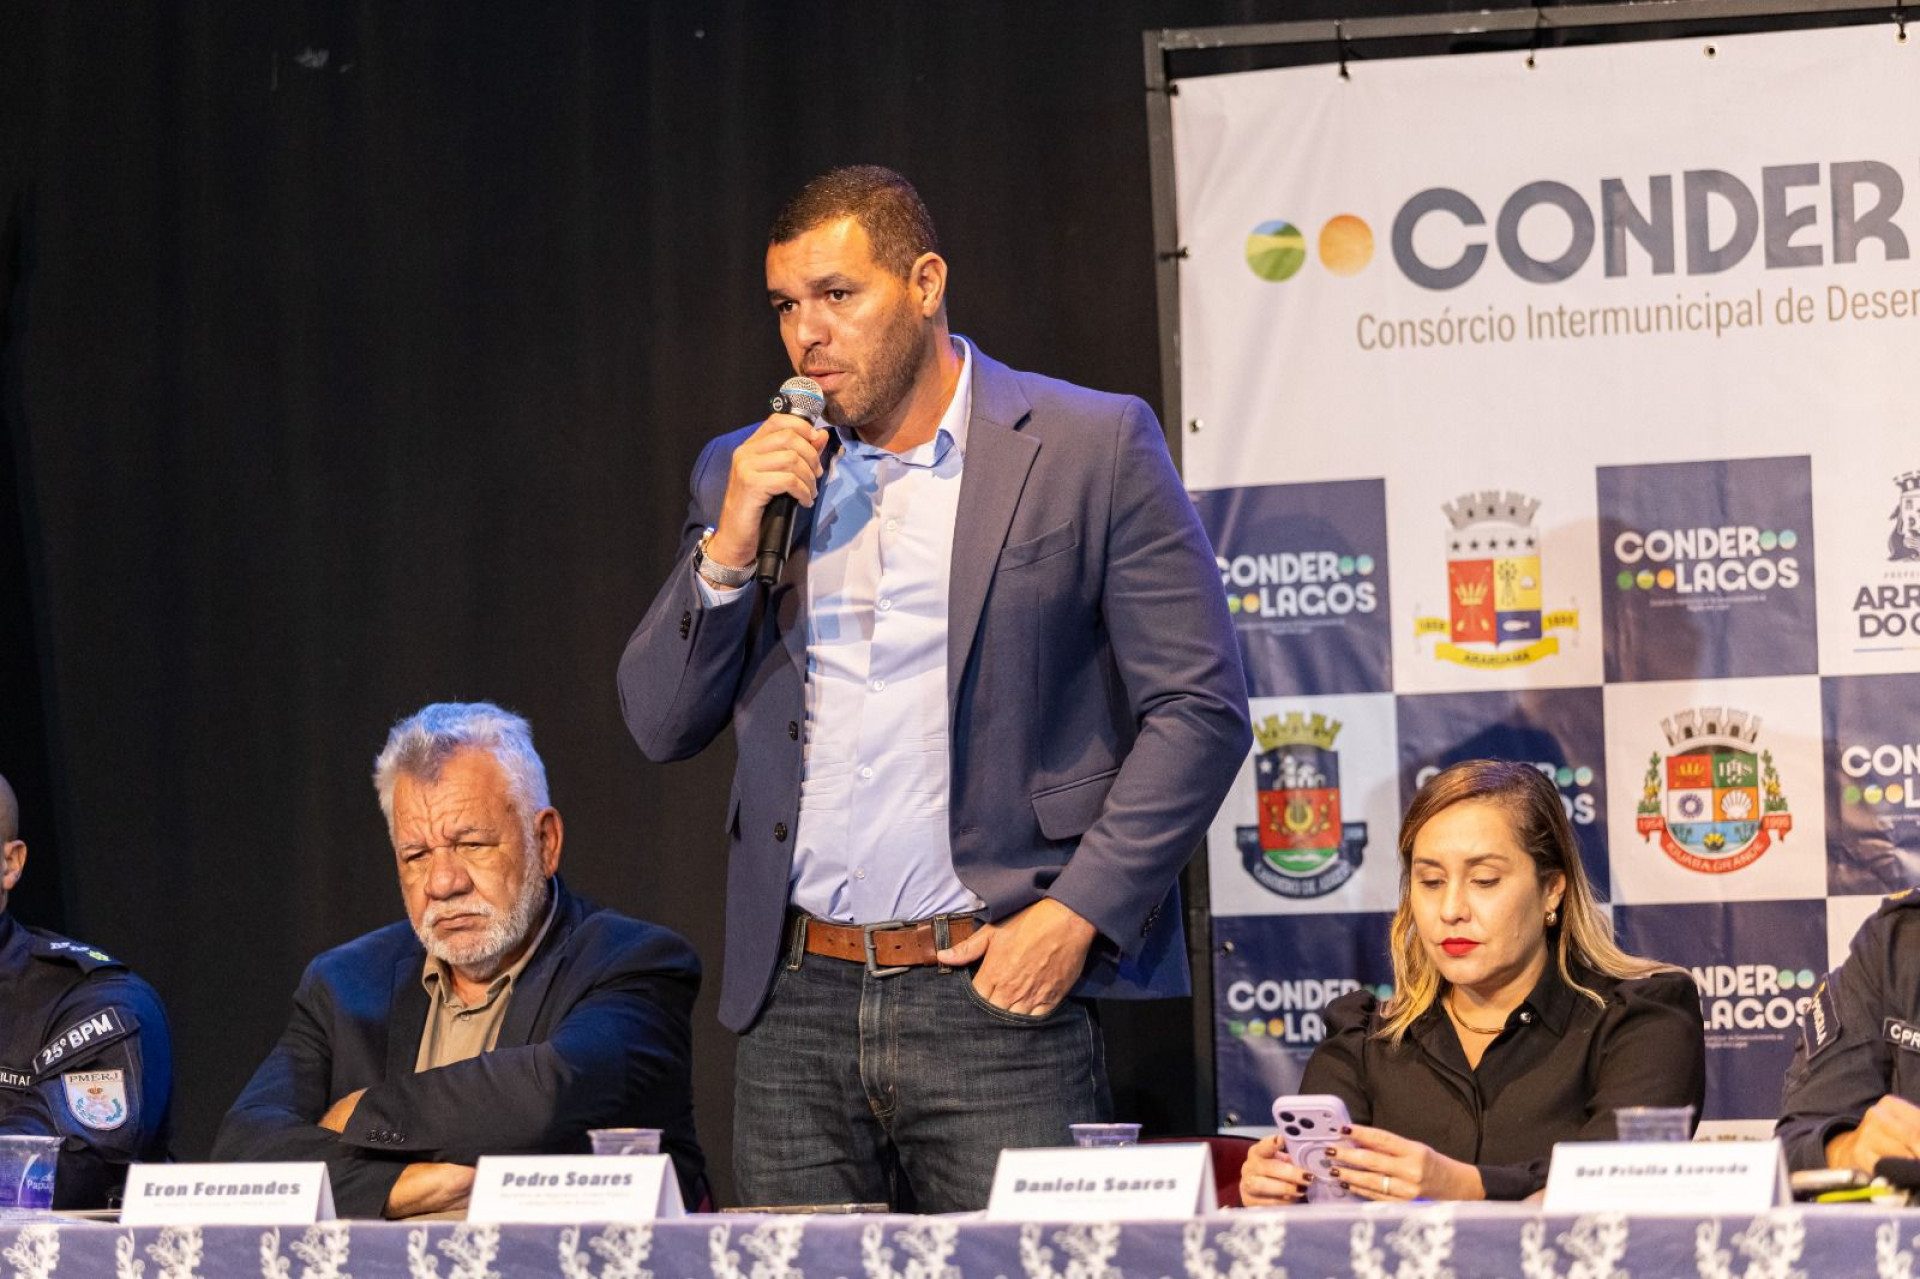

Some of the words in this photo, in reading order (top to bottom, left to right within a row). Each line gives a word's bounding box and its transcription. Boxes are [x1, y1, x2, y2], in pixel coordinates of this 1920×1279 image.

[1391, 160, 1910, 290] CONDER
[1356, 305, 1516, 350] Consórcio
[1527, 287, 1763, 339] Intermunicipal
[1775, 287, 1814, 325] de
[1614, 526, 1762, 564] CONDER
[1675, 557, 1800, 594] LAGOS
[1259, 581, 1377, 618] LAGOS
[1859, 613, 1907, 638] DO
[1284, 1012, 1326, 1042] LA
[1700, 997, 1813, 1030] AGOS
[69, 1072, 118, 1083] PMERJ
[144, 1182, 188, 1197] Eron
[194, 1181, 300, 1196] Fernandes
[501, 1171, 559, 1187] Pedro
[565, 1170, 633, 1186] Soares
[1014, 1177, 1097, 1193] Daniela
[1104, 1176, 1177, 1192] Soares
